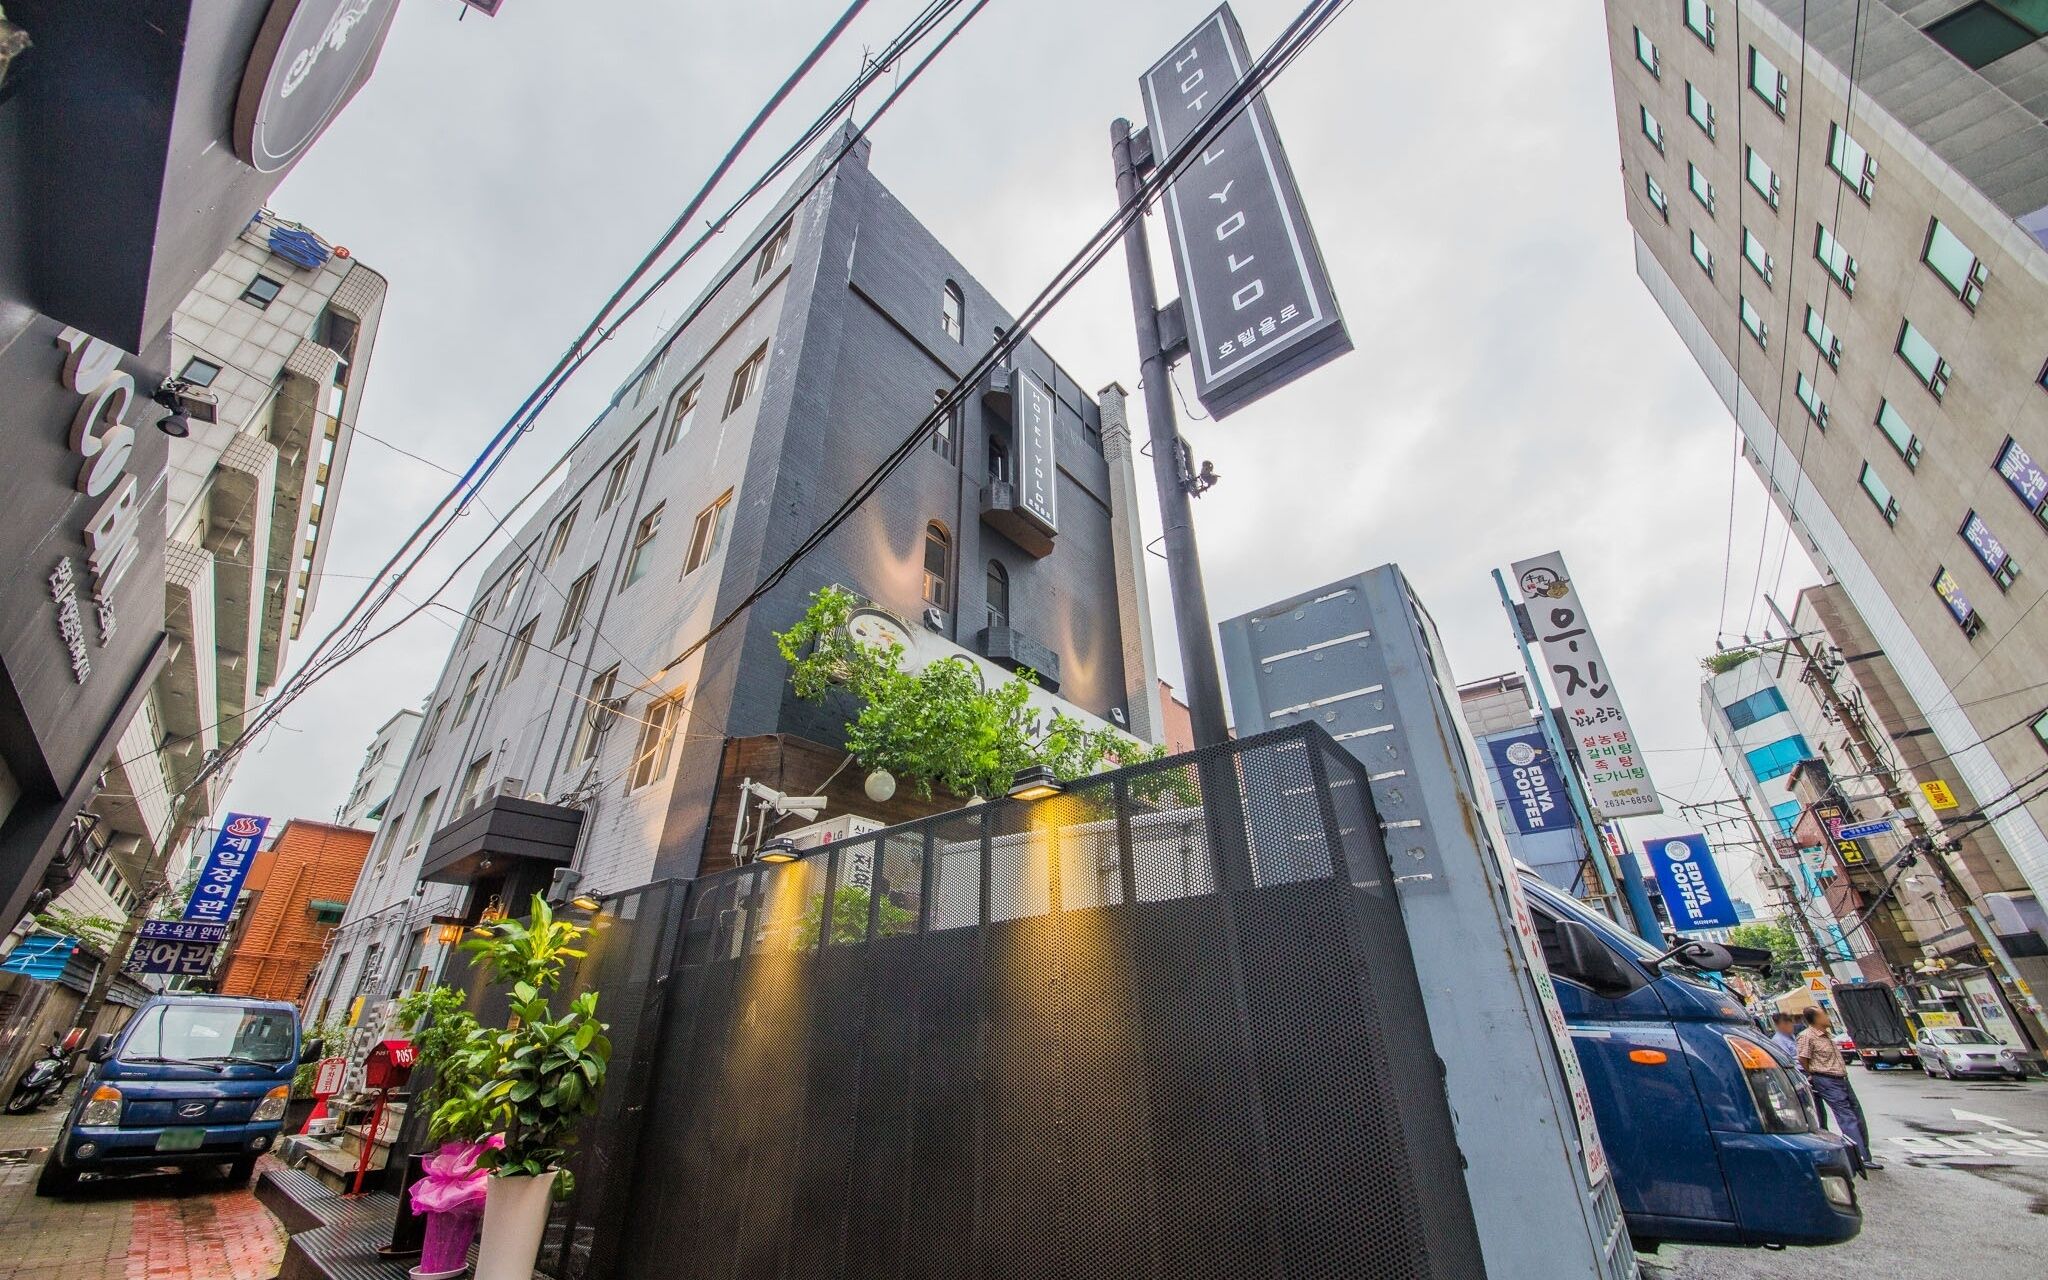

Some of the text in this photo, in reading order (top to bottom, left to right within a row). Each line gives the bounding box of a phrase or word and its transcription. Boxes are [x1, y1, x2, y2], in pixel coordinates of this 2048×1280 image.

[1176, 47, 1265, 311] HOTL YOLO
[1218, 303, 1300, 360] 호텔욜로
[1032, 391, 1044, 505] HOTEL YOLO
[2000, 442, 2047, 501] 백내장 수술
[1967, 516, 2004, 566] 망막 수술
[1543, 608, 1609, 699] 우진
[1583, 731, 1627, 748] 설농탕
[1587, 743, 1632, 760] 갈비탕
[1513, 767, 1545, 828] COFFEE
[1527, 765, 1555, 813] EDIYA
[1593, 767, 1645, 784] 도가니탕
[1925, 783, 1948, 804] 원룸
[1604, 794, 1653, 809] 2634-6850
[1838, 840, 1864, 863] 치킨
[195, 837, 253, 915] 제일장여관
[1670, 862, 1703, 919] COFFEE
[1684, 861, 1712, 907] EDIYA
[200, 925, 225, 940] 완비
[152, 941, 216, 973] 여관
[395, 1048, 413, 1063] POST
